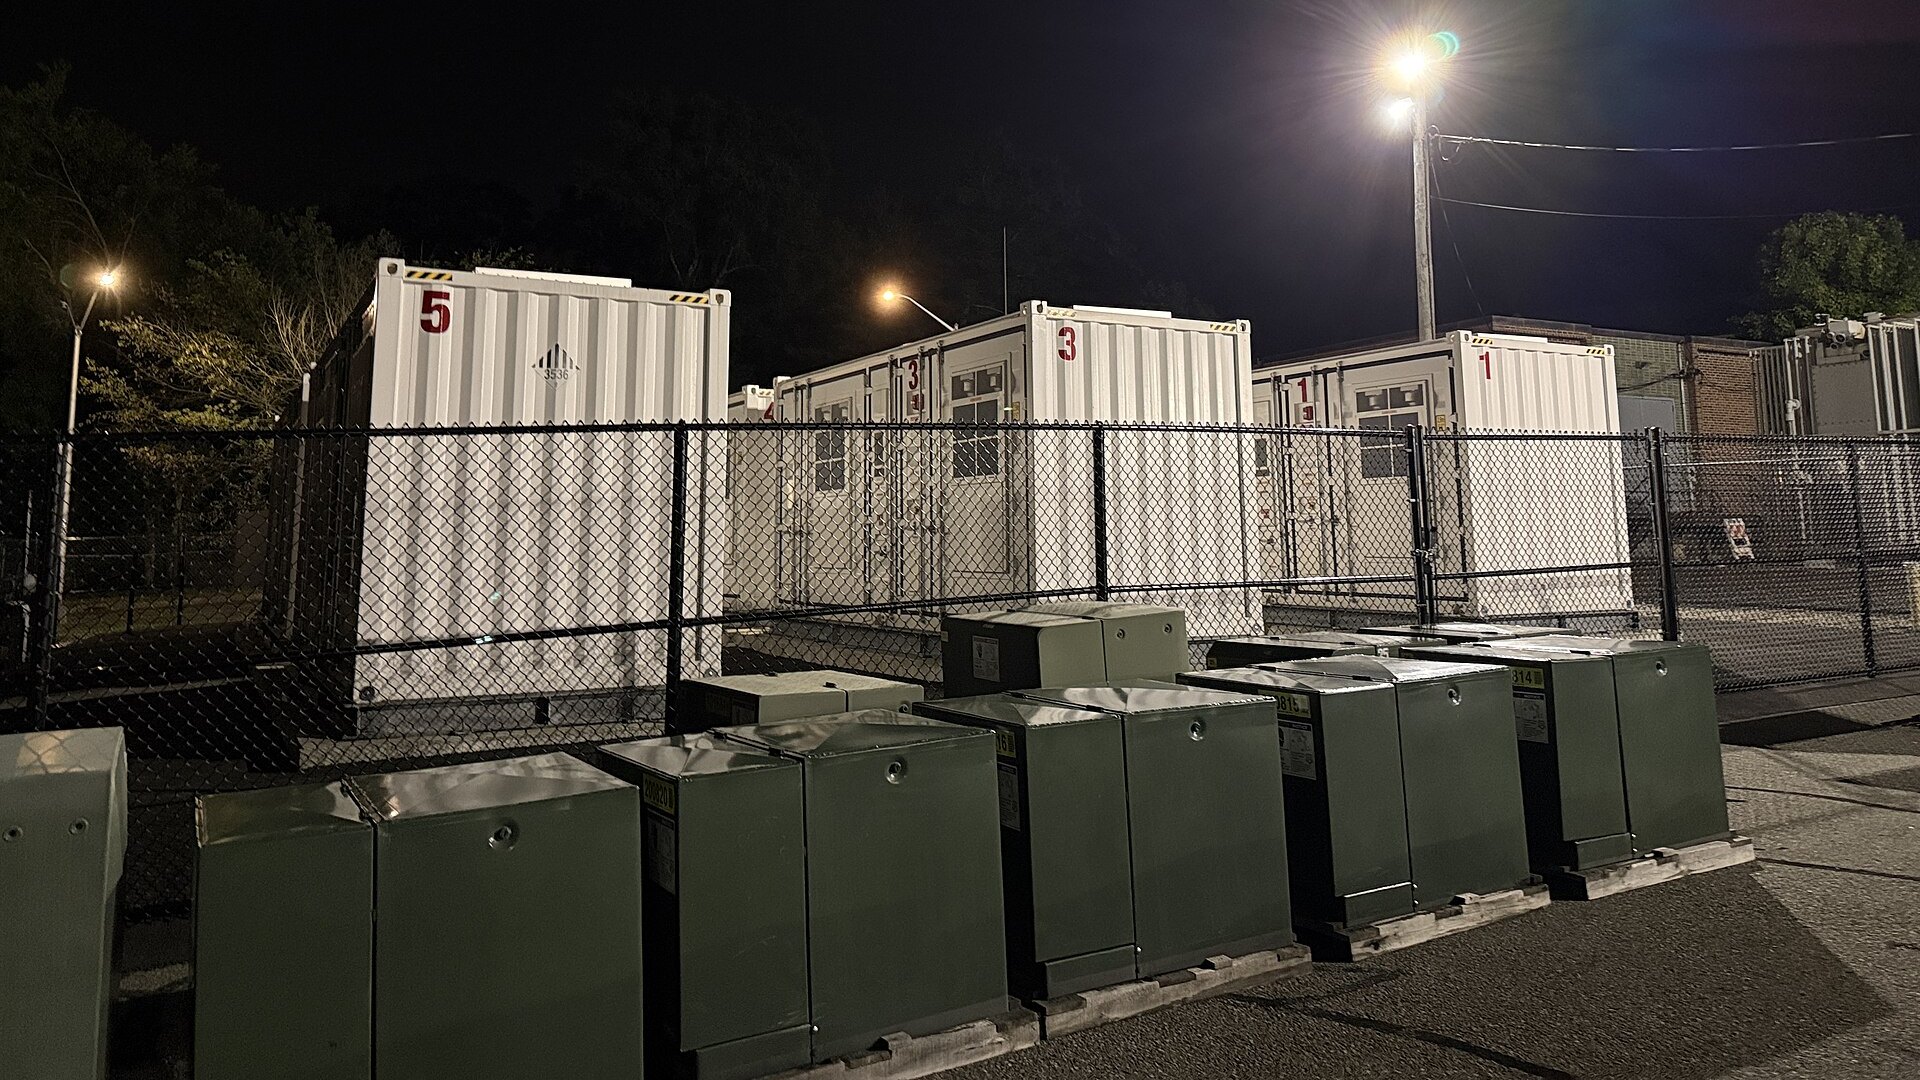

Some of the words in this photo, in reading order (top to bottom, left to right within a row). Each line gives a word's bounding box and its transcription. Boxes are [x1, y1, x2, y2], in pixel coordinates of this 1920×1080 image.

[421, 290, 450, 333] 5
[1058, 327, 1076, 361] 3
[544, 369, 569, 380] 3536
[909, 360, 919, 390] 3
[1480, 351, 1491, 379] 1
[1298, 377, 1308, 403] 1
